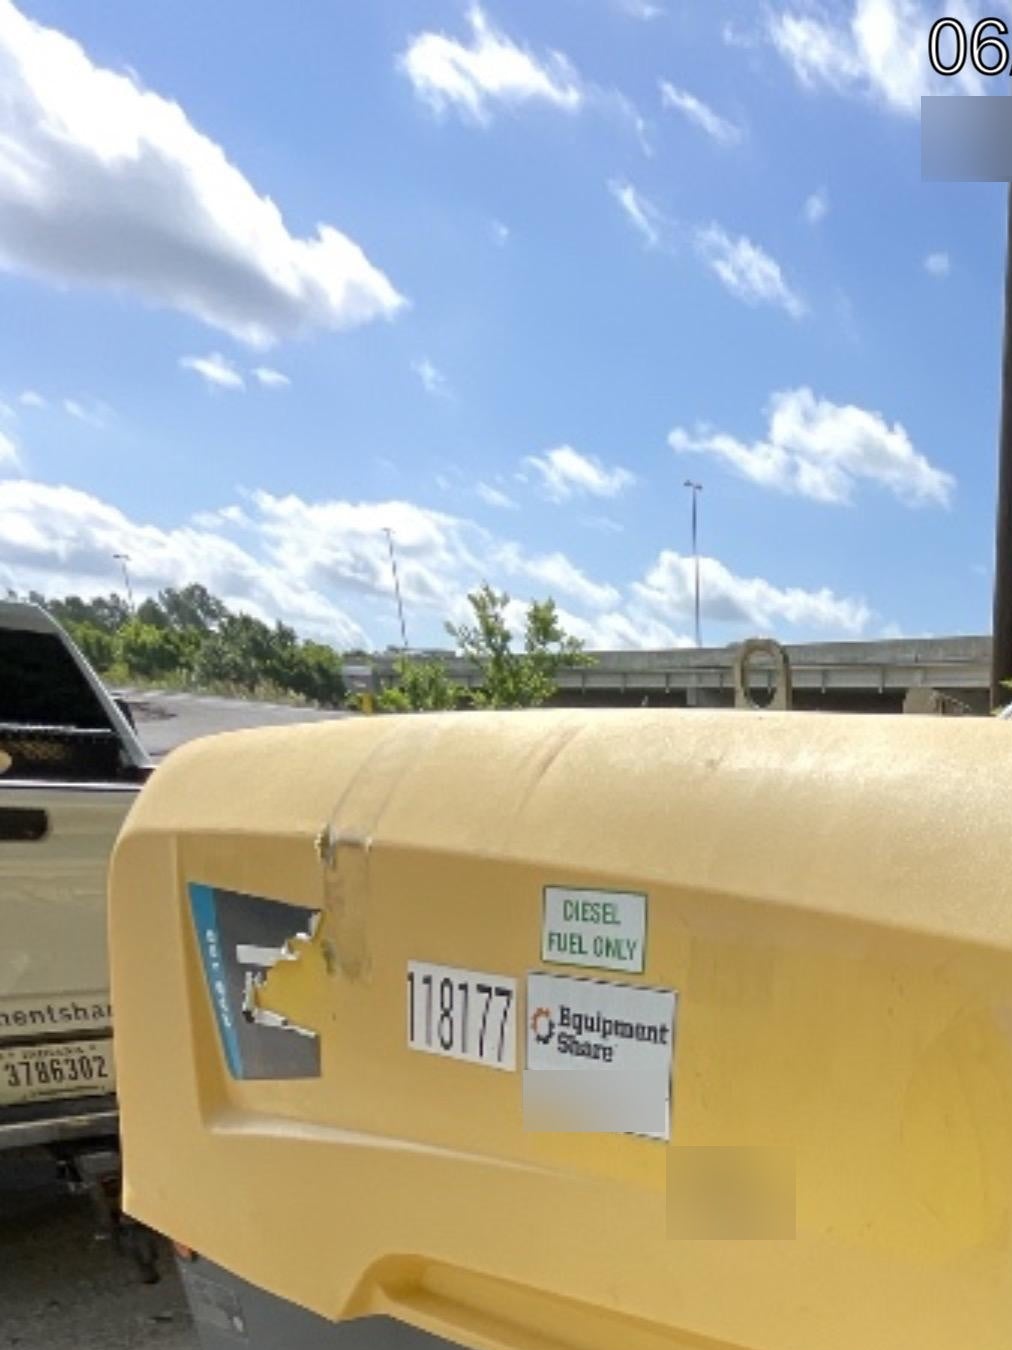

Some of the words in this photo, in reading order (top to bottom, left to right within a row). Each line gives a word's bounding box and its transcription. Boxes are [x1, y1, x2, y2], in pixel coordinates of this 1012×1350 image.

[562, 899, 621, 926] DIESEL
[547, 931, 588, 956] FUEL
[593, 935, 638, 961] ONLY
[406, 970, 513, 1063] 118177
[559, 1005, 669, 1046] Equipment
[557, 1033, 614, 1063] Share
